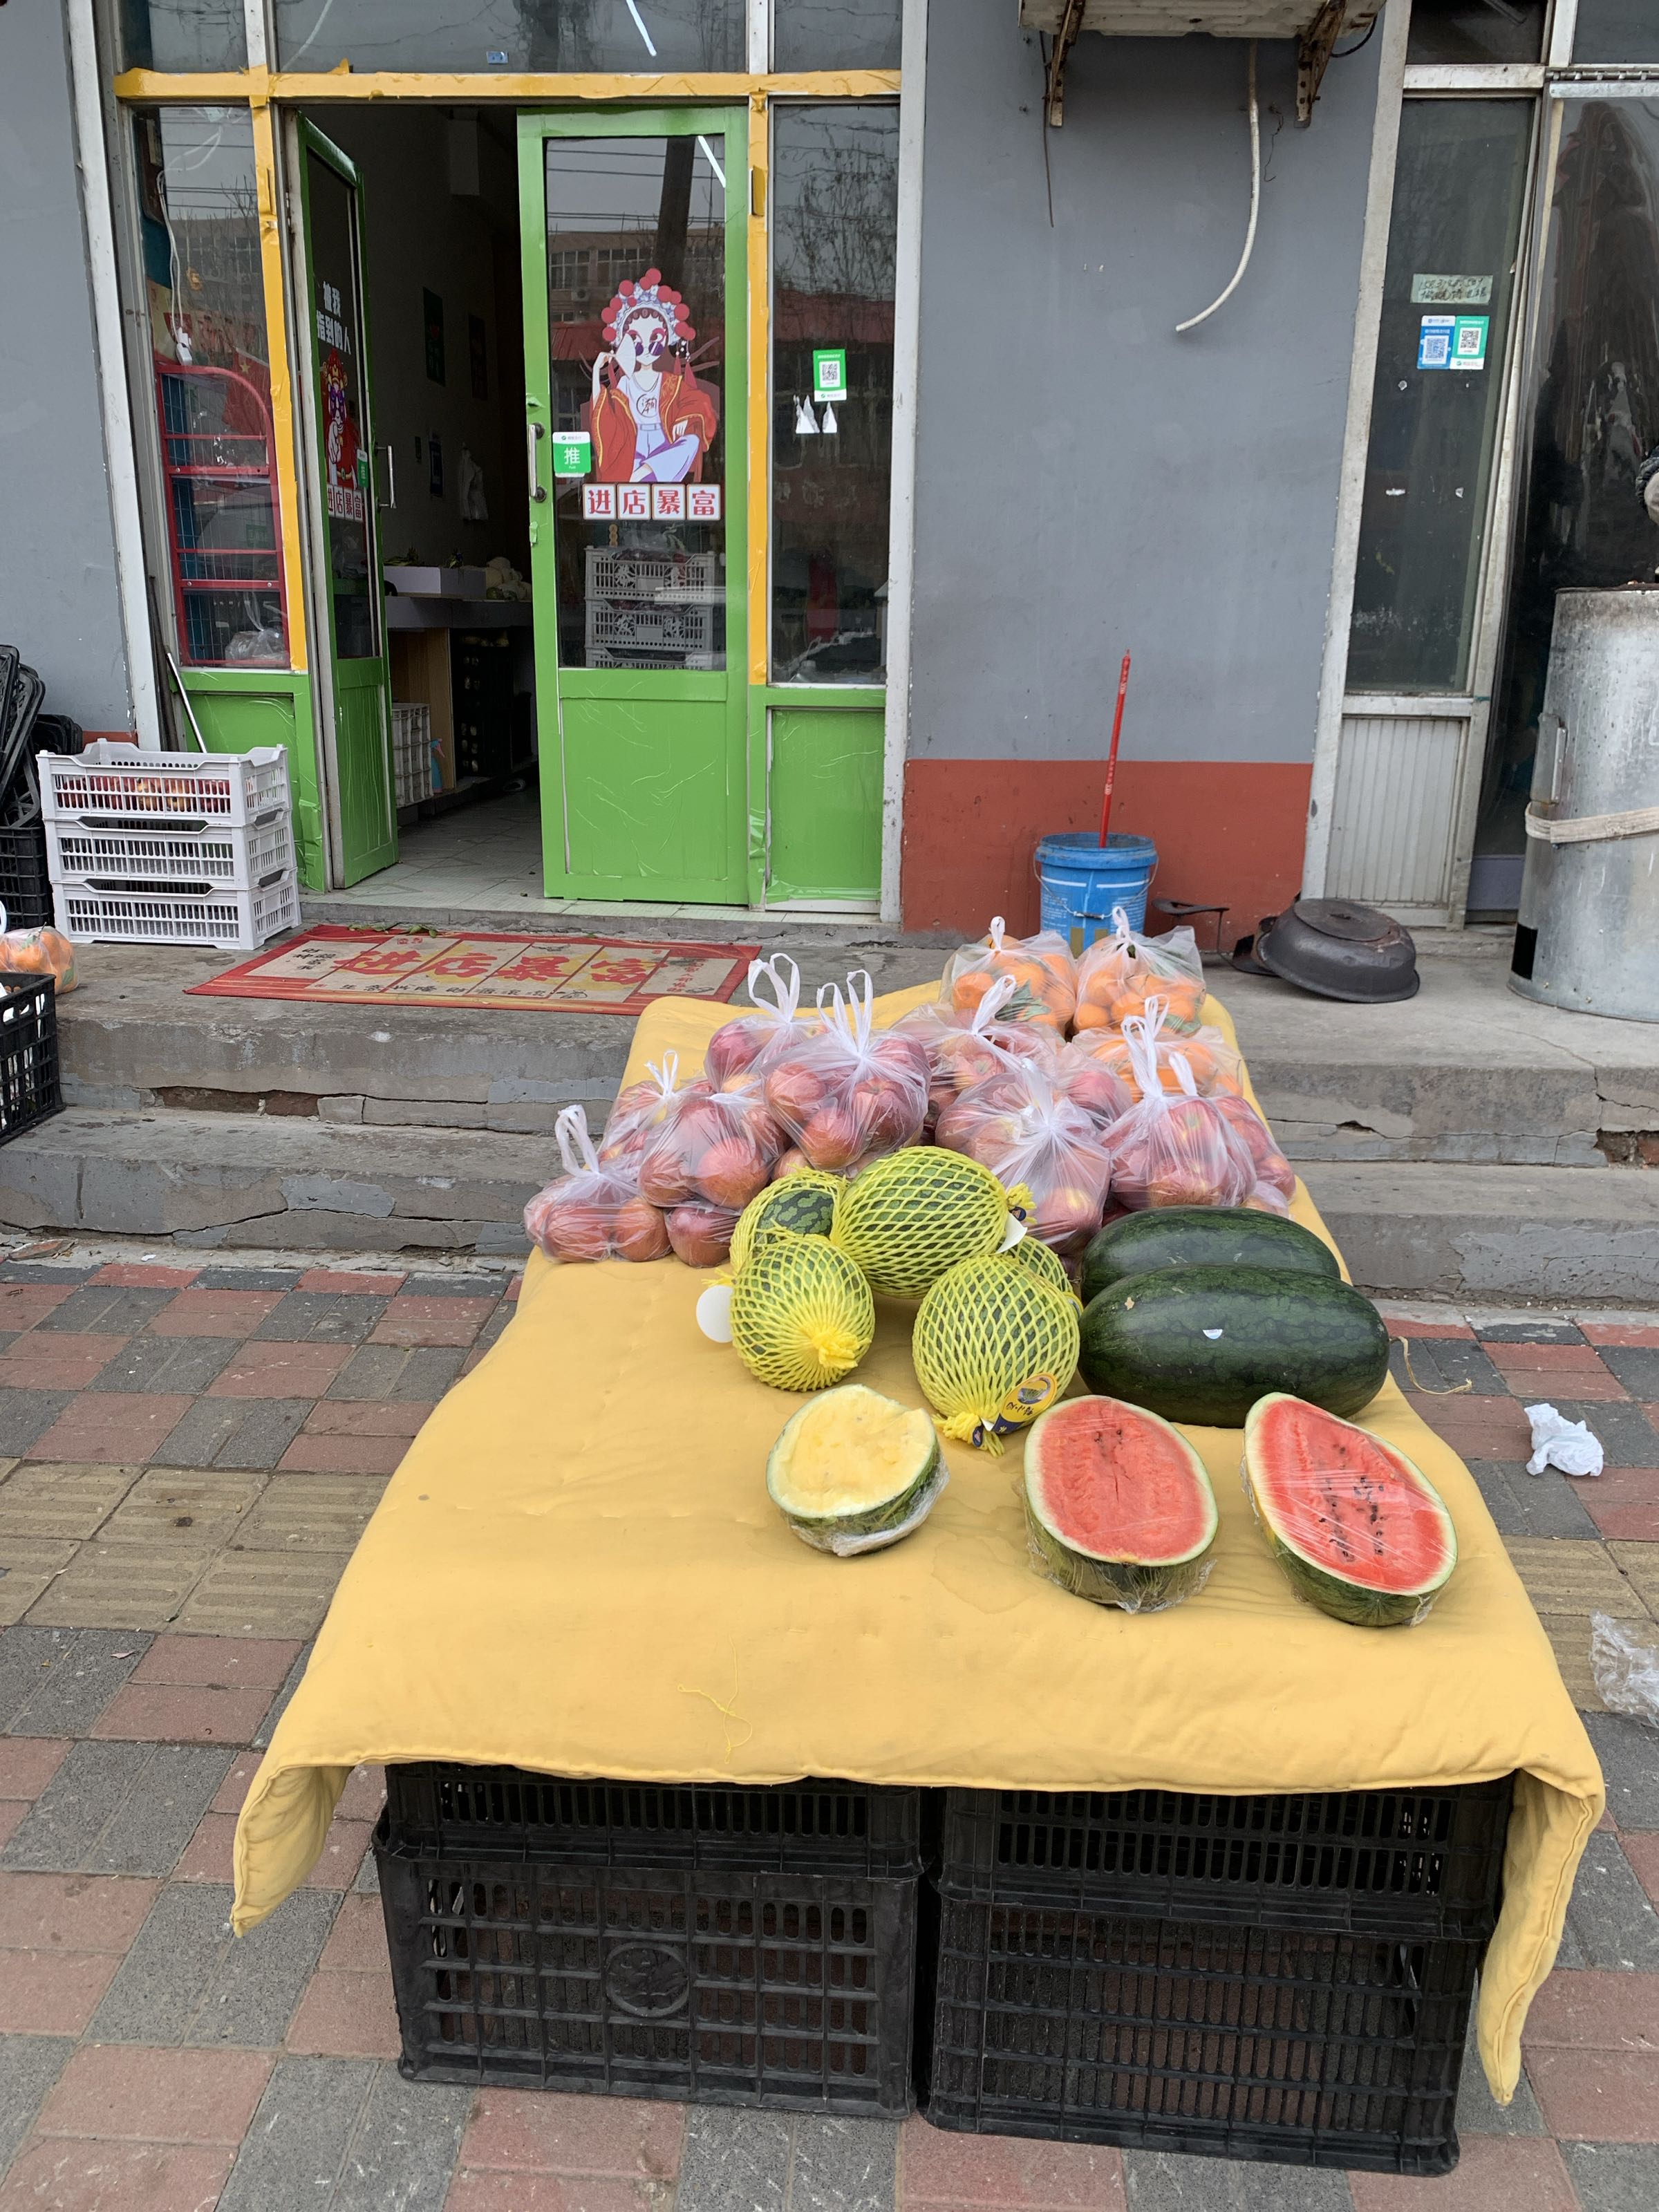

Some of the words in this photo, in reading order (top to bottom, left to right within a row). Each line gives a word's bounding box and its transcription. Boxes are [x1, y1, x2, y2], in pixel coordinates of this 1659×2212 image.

[316, 310, 351, 355] 指到的人
[563, 447, 581, 465] 推
[588, 489, 715, 515] 进店暴富
[332, 950, 666, 986] 进店暴富
